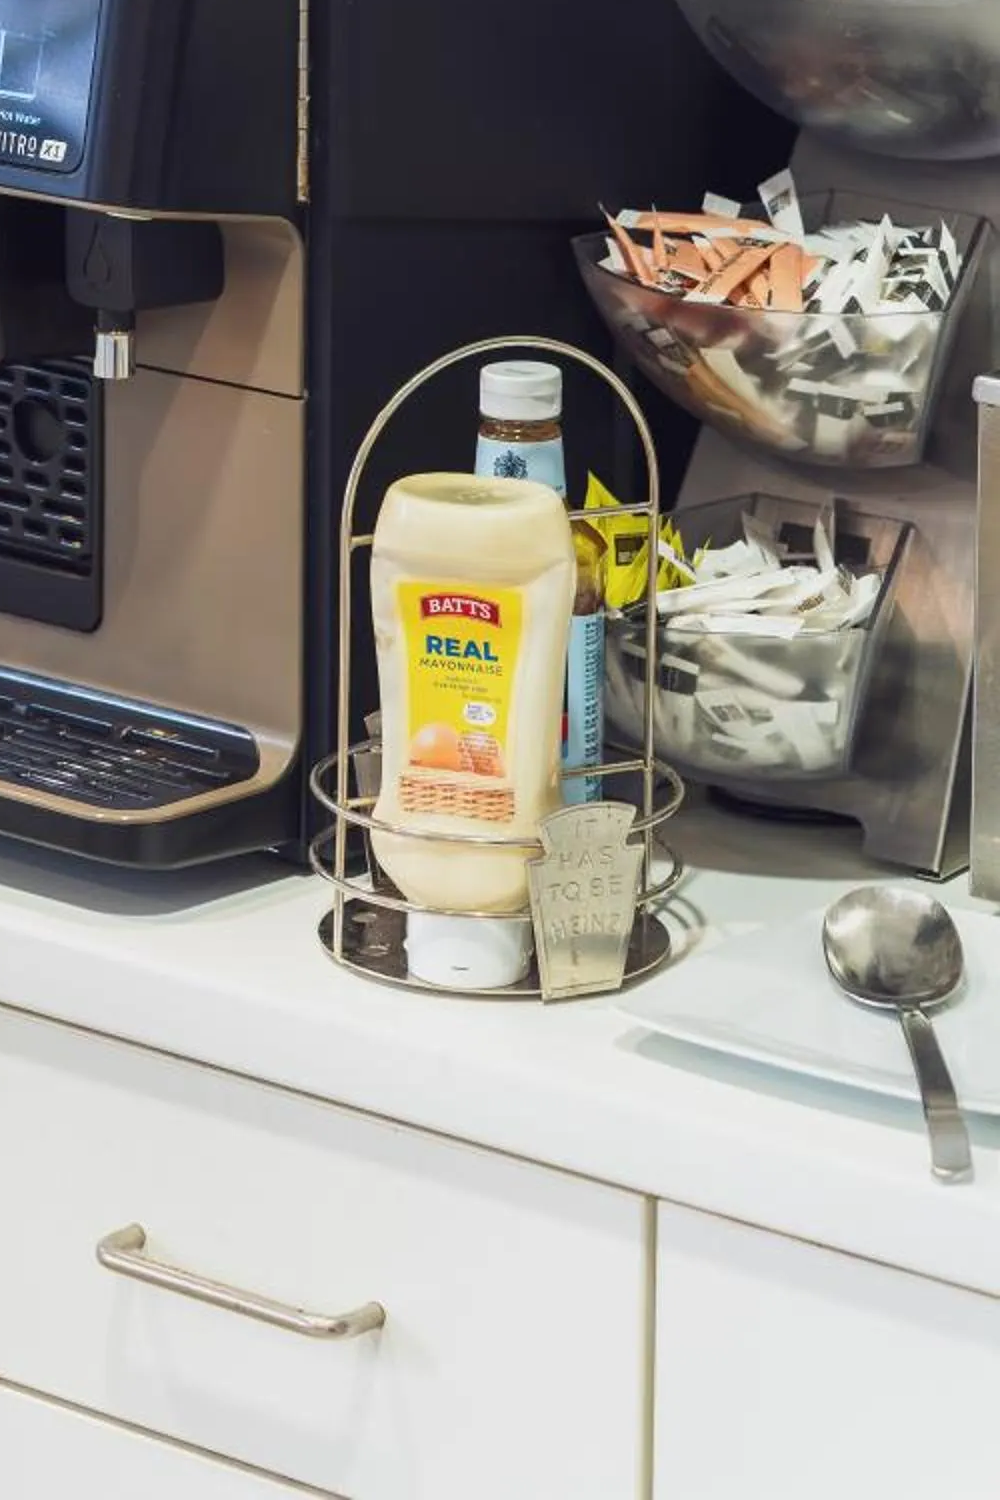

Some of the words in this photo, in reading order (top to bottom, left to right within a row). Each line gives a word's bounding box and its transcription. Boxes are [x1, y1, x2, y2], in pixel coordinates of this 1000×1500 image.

[428, 596, 492, 620] BATTS
[426, 634, 500, 663] REAL
[419, 657, 504, 678] MAYONNAISE
